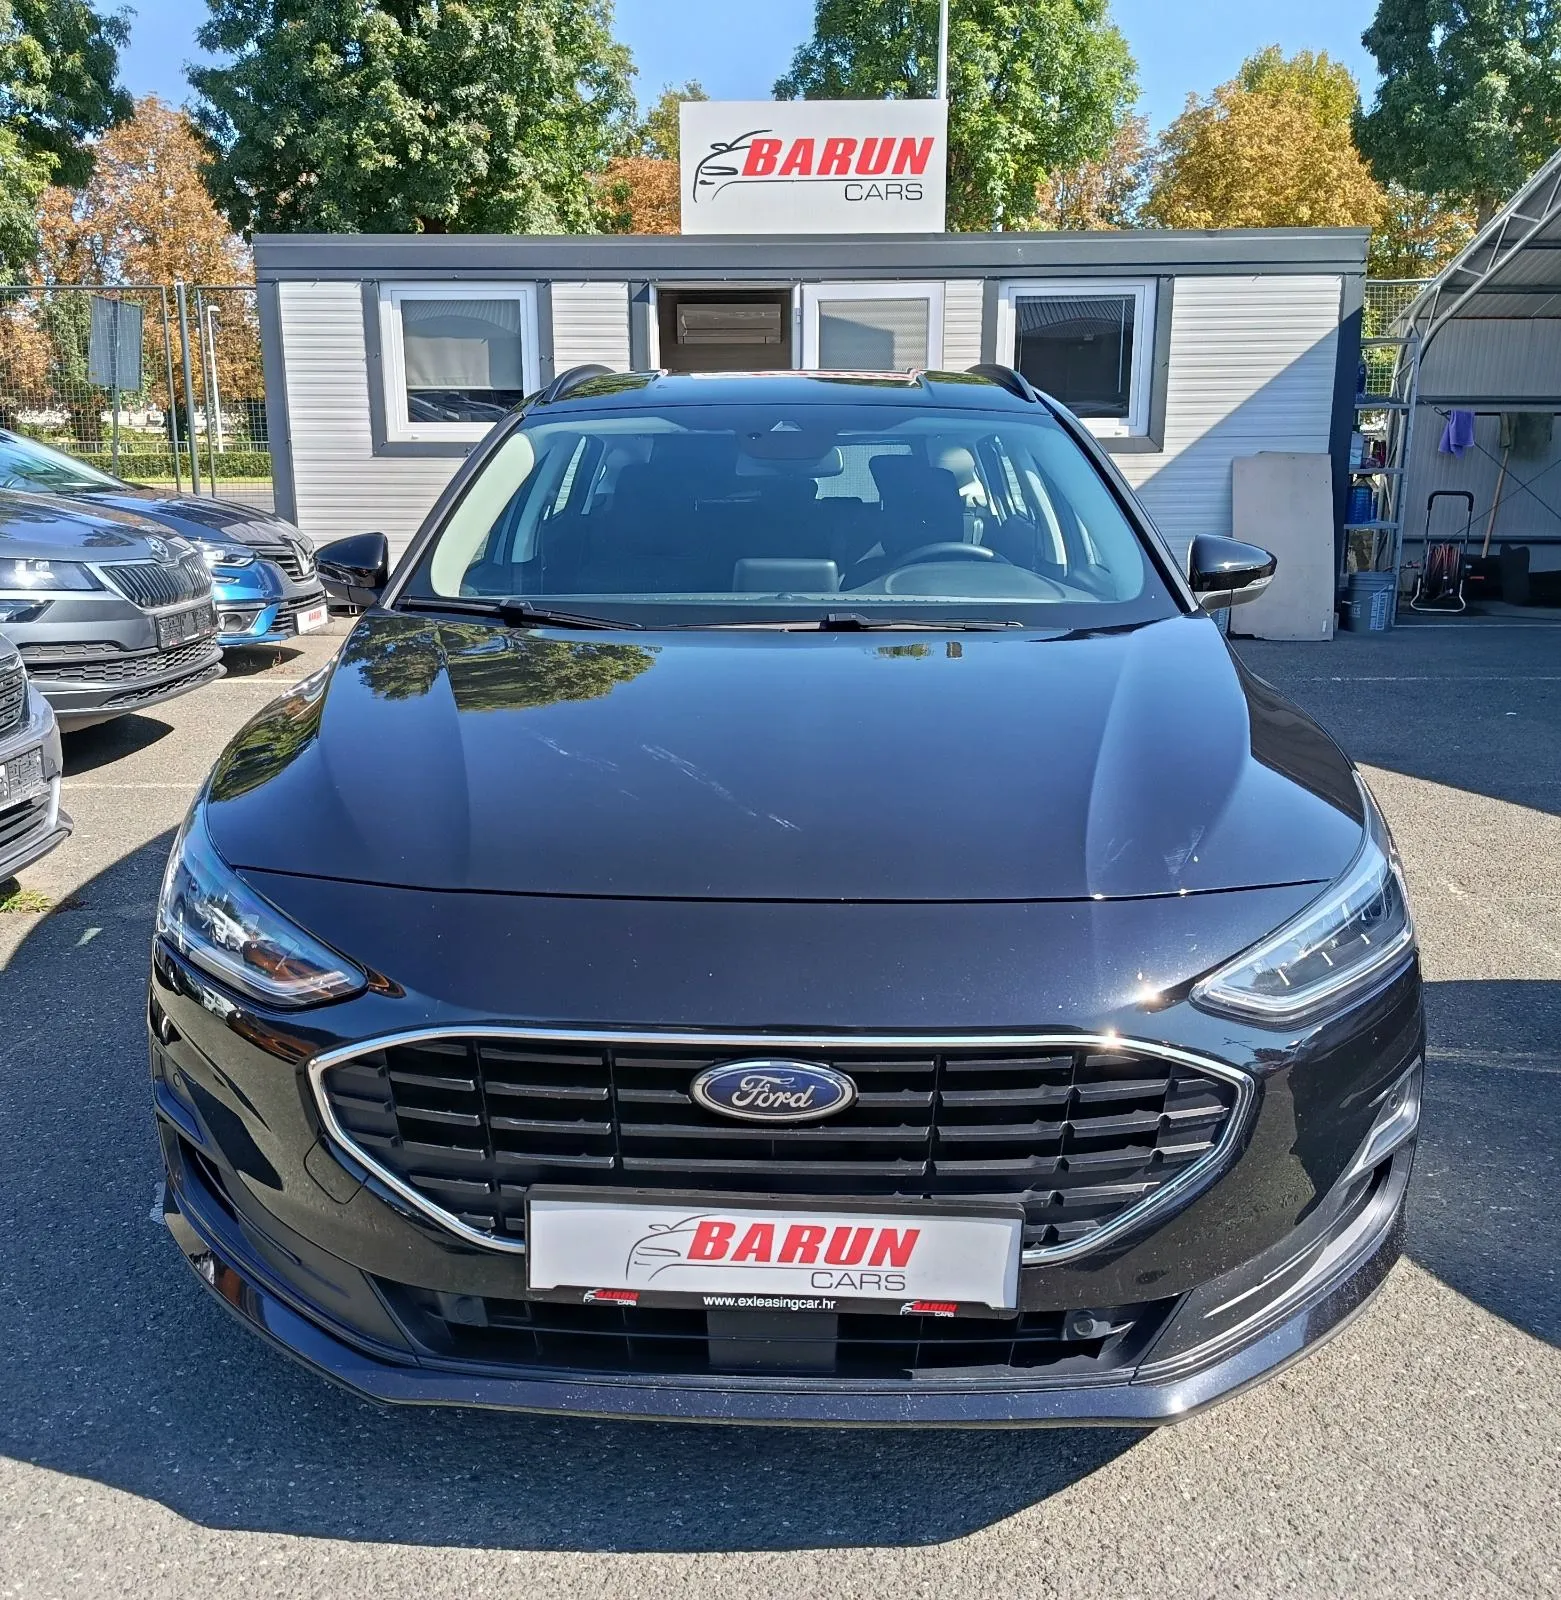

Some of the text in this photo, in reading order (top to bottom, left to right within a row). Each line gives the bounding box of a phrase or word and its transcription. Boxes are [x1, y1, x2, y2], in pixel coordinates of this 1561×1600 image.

[741, 137, 935, 177] BARUN
[844, 183, 923, 201] CARS
[731, 1075, 816, 1108] Ford
[686, 1220, 921, 1268] BARUN
[811, 1271, 906, 1291] CARS
[703, 1295, 836, 1311] www.exleasingcar.hr
